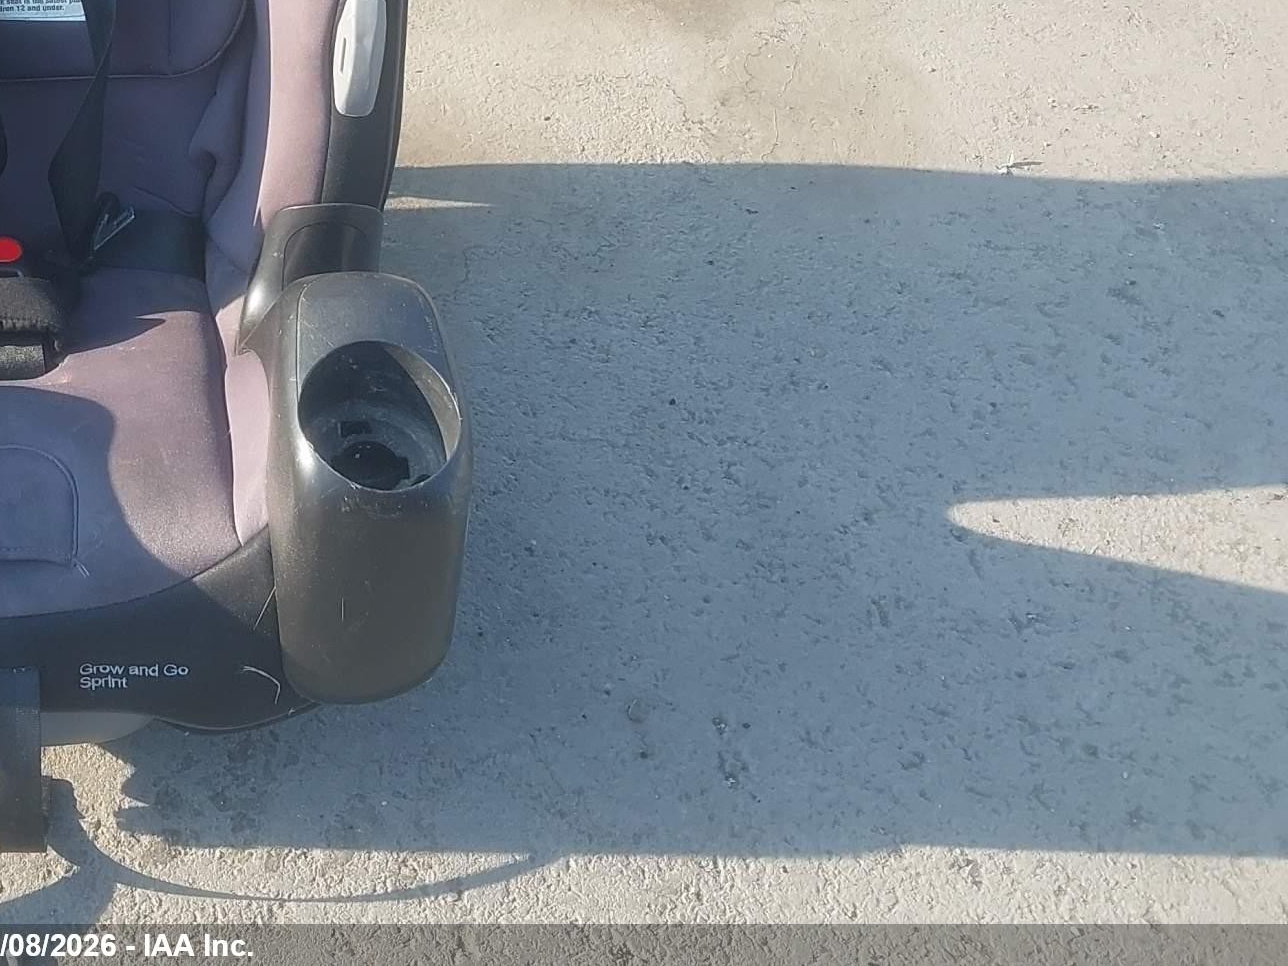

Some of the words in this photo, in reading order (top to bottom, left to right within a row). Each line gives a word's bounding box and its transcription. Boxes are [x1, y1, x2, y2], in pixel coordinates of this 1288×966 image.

[42, 4, 65, 12] under.
[79, 662, 125, 675] Grow
[128, 663, 159, 677] and
[163, 663, 189, 676] Go
[79, 675, 128, 690] Sprint
